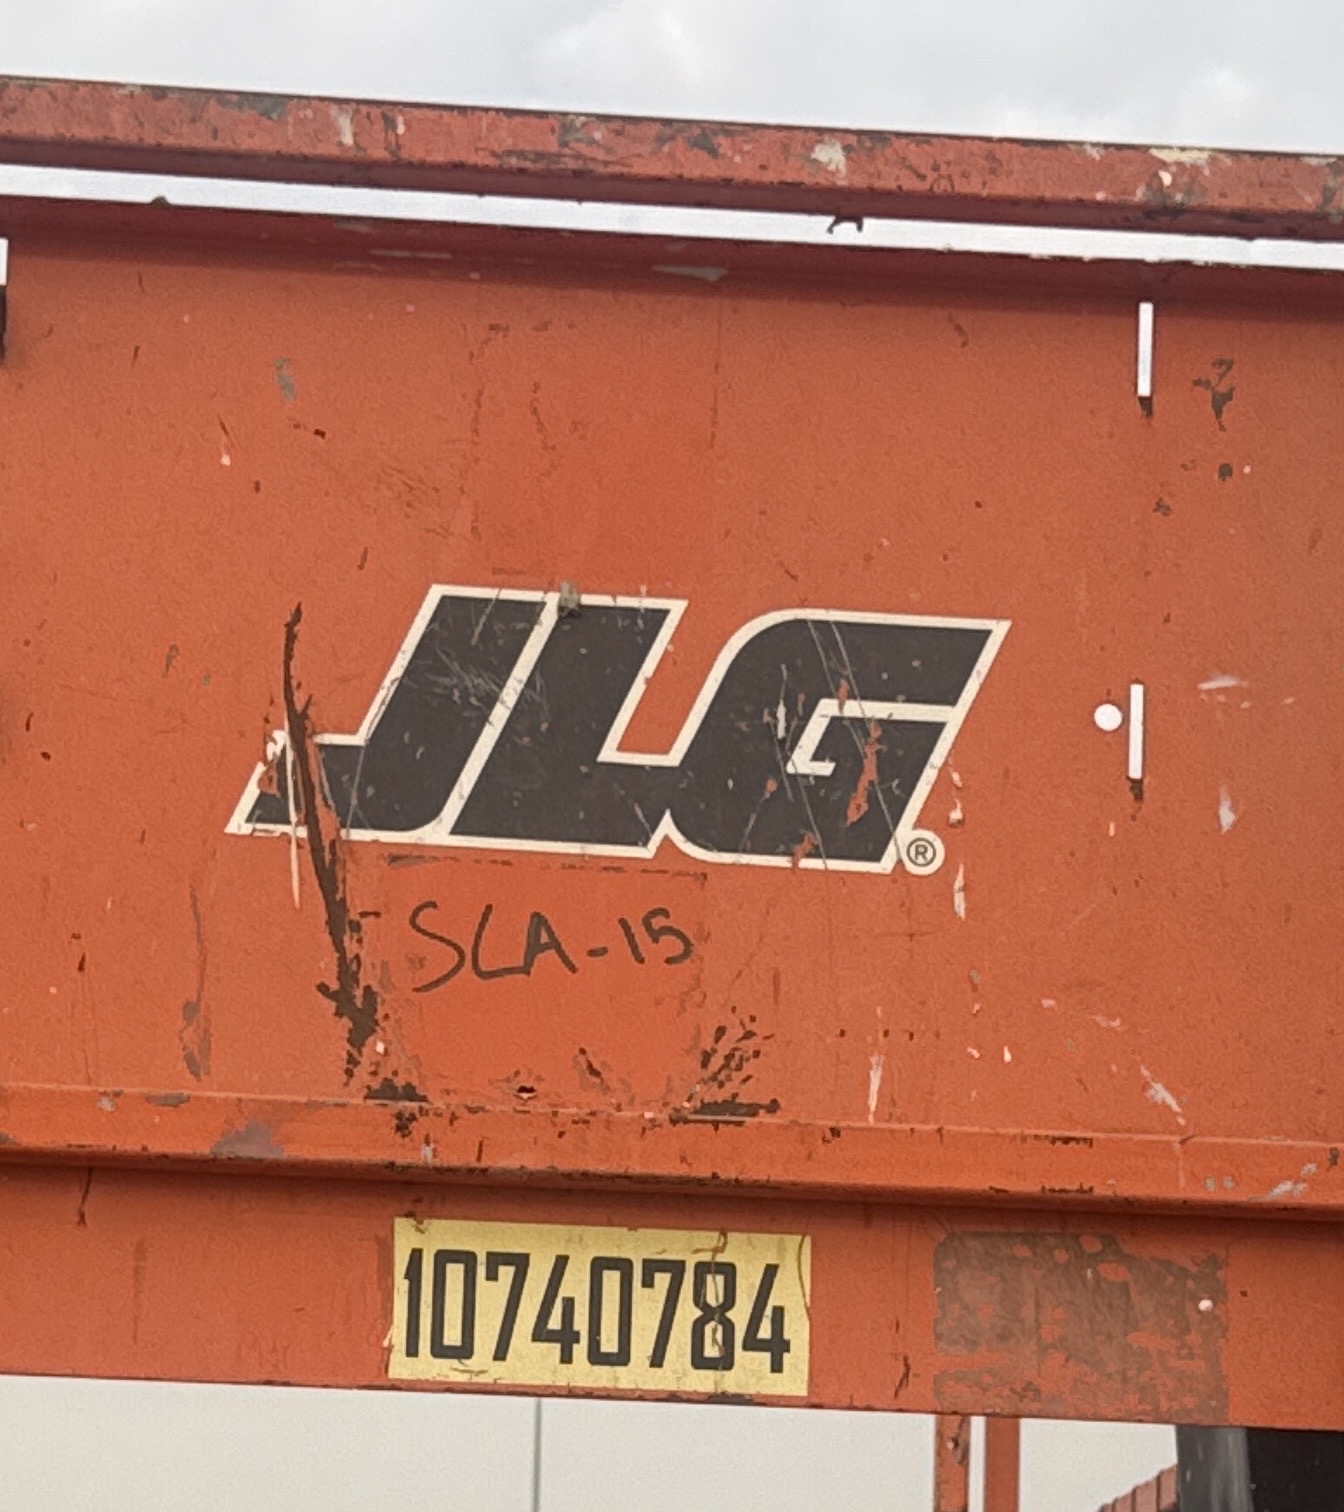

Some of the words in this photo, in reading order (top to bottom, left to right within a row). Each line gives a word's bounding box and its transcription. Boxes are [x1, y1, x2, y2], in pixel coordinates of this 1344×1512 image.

[224, 584, 1012, 874] JLG
[407, 903, 694, 993] SLA-15
[403, 1247, 790, 1374] 10740784
